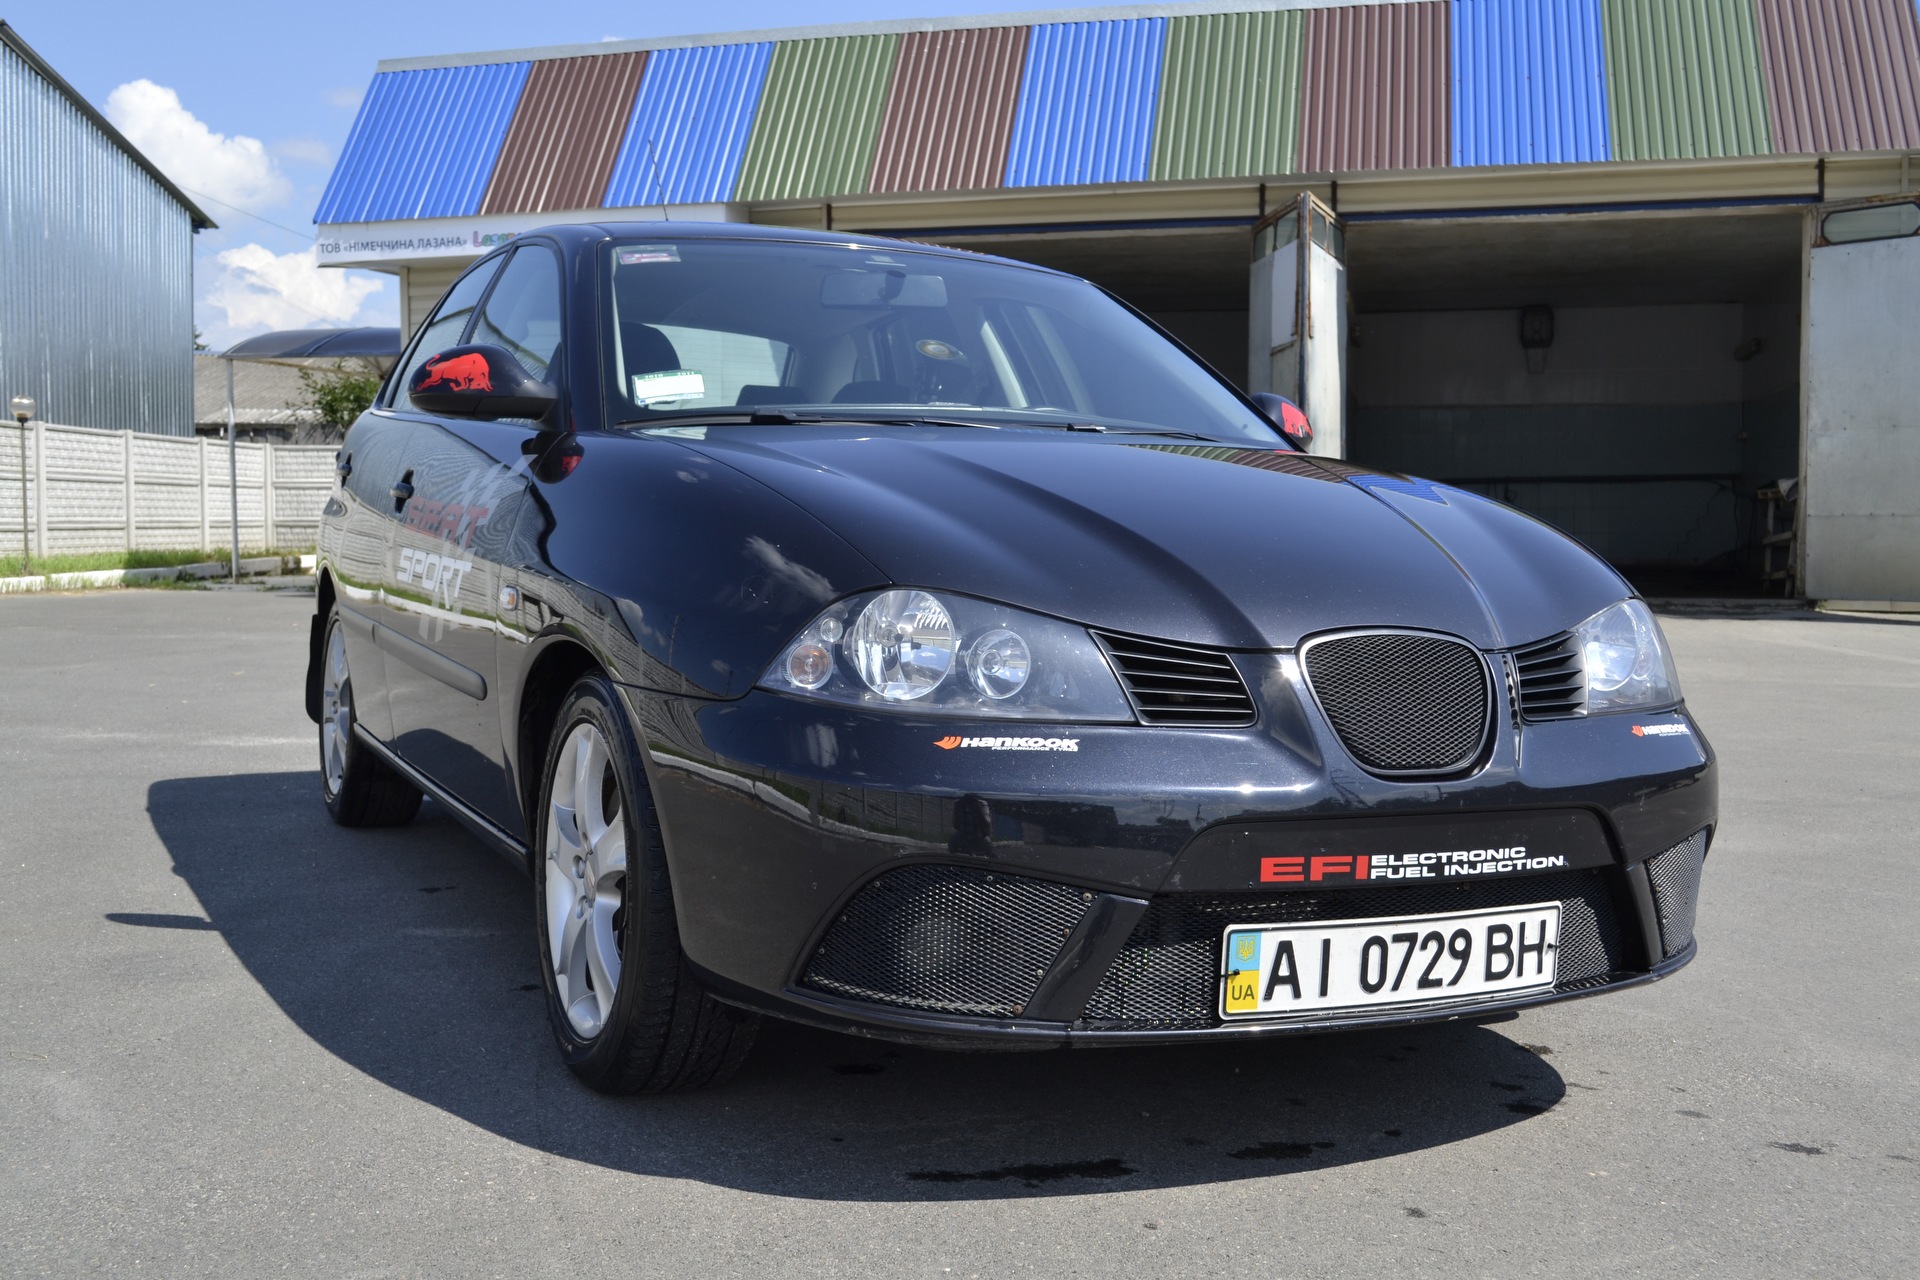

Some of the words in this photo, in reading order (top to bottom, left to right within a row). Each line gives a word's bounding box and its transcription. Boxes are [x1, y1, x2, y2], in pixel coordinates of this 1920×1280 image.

[319, 242, 341, 254] ТОВ
[343, 239, 415, 252] «НІМЕЧЧИНА
[417, 236, 468, 249] ЛАЗАНА»
[406, 497, 489, 548] SEAT
[397, 548, 472, 609] SPORT
[1260, 855, 1370, 882] EFI
[1370, 866, 1435, 879] FUEL
[1443, 856, 1564, 876] INJECTION
[1371, 847, 1526, 866] ELECTRONIC
[1360, 928, 1473, 994] 0729
[1485, 919, 1548, 983] BH
[1231, 984, 1256, 1001] UA
